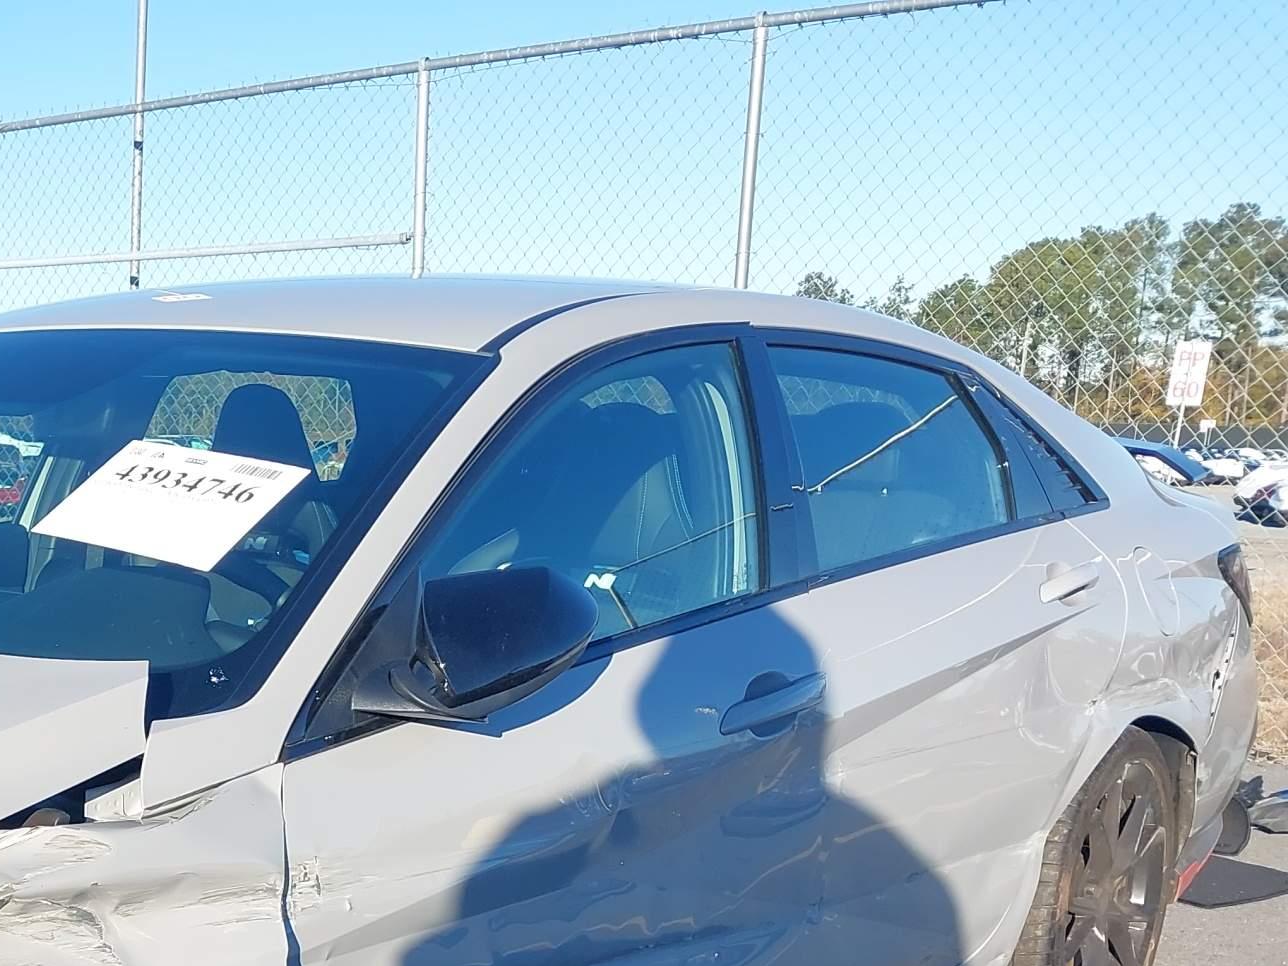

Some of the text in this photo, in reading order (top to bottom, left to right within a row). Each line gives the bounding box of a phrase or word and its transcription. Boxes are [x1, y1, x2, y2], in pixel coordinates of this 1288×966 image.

[1179, 351, 1205, 367] PP
[1173, 382, 1199, 398] 60
[115, 464, 261, 504] 43934746
